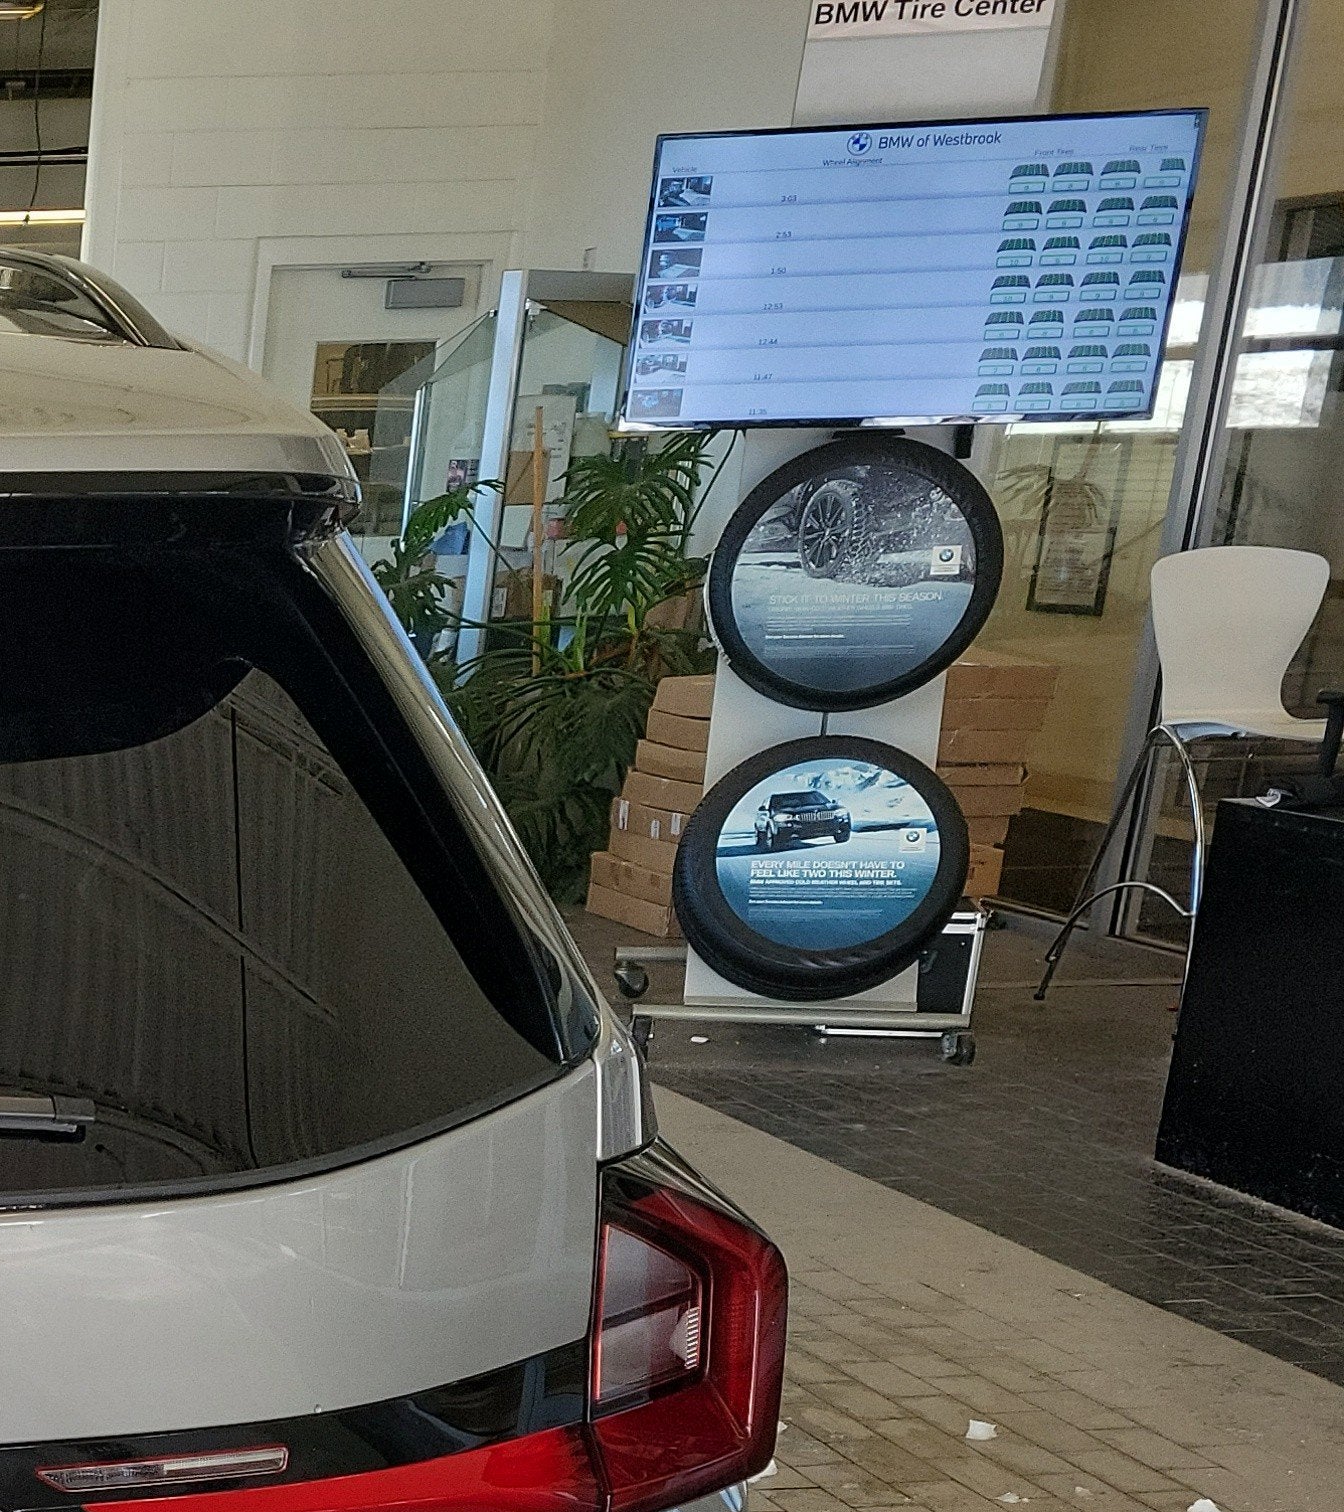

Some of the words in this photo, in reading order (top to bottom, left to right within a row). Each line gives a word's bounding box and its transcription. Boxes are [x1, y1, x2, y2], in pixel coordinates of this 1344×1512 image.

[815, 0, 887, 24] BMW
[895, 0, 945, 20] Tire
[954, 0, 1046, 17] Center
[878, 134, 914, 150] BMW
[916, 133, 931, 148] of
[933, 131, 1002, 147] Westbrook
[822, 158, 846, 167] Wheel
[847, 156, 883, 166] Alignment
[672, 165, 698, 174] Vehicle
[769, 594, 798, 604] STICK
[815, 594, 828, 603] TO
[831, 593, 870, 603] WINTER
[873, 593, 896, 603] THIS
[899, 591, 943, 602] SEASON.
[751, 860, 785, 869] EVERY
[786, 860, 811, 869] MILE
[812, 860, 858, 869] DOESN'T
[860, 861, 888, 869] HAVE
[890, 861, 905, 869] TO
[750, 869, 776, 878] FEEL
[777, 869, 800, 878] LIKE
[802, 869, 827, 878] TWO
[829, 869, 852, 878] THIS
[854, 869, 897, 878] WINTER.
